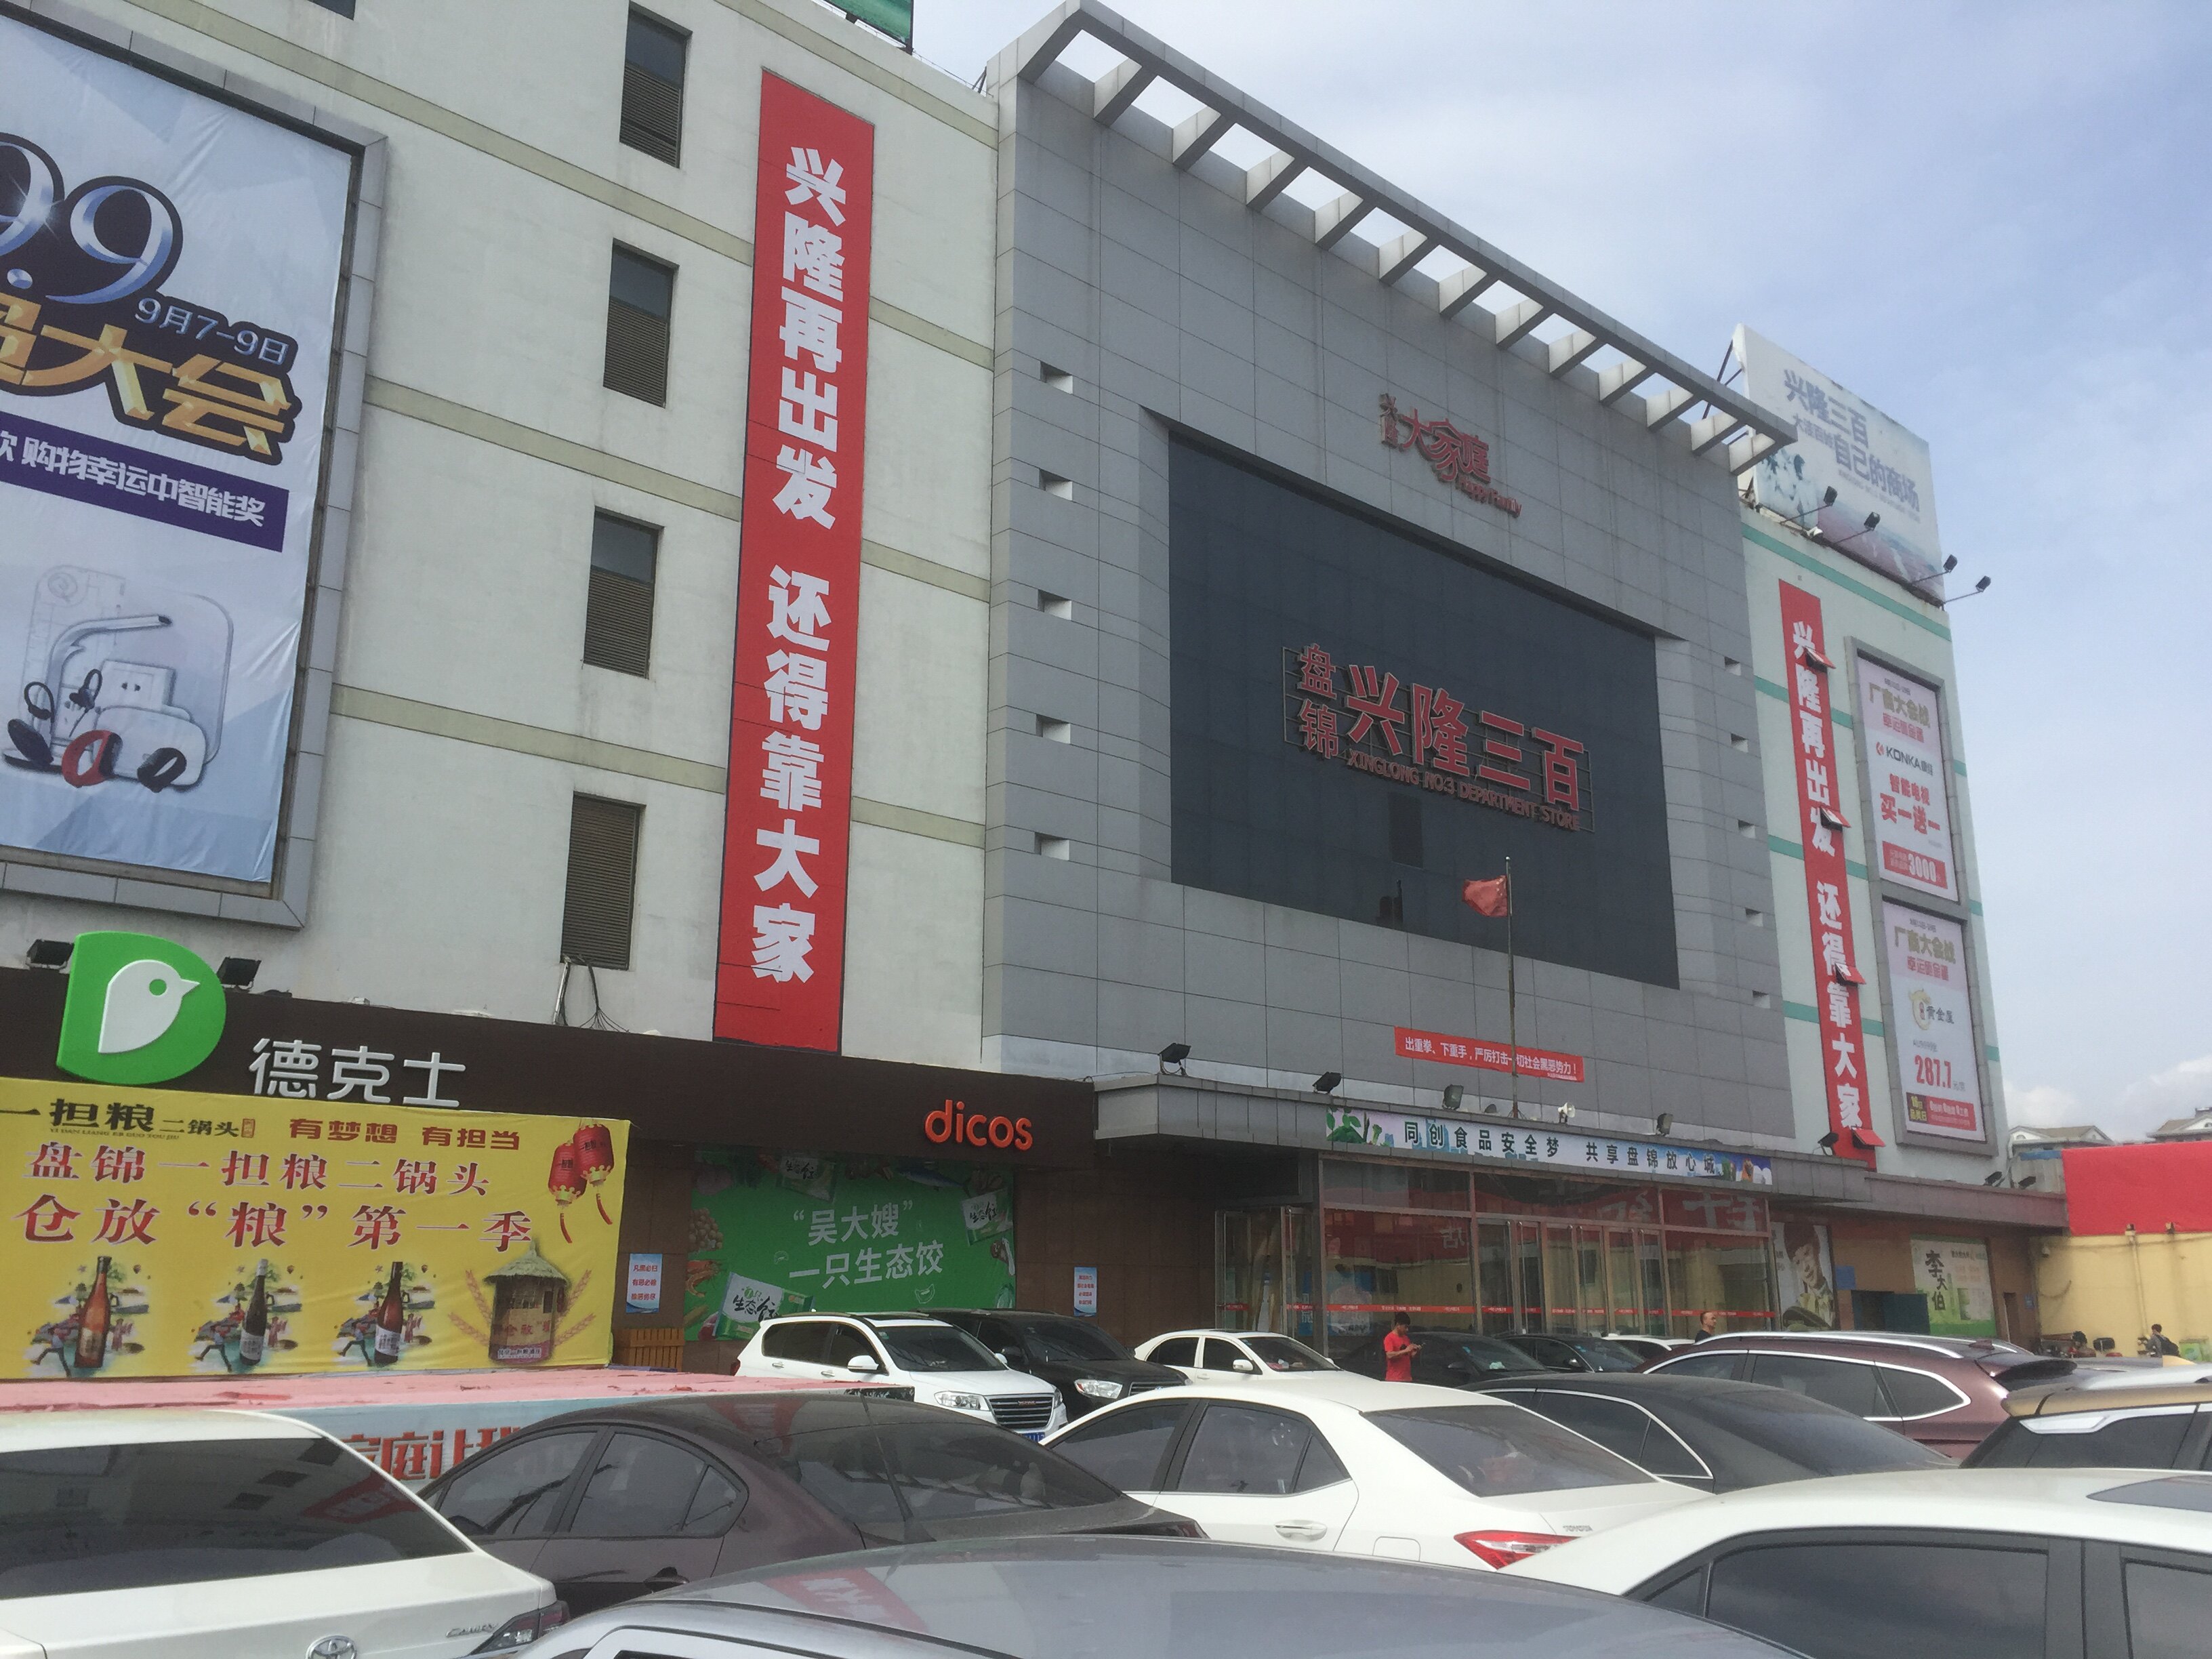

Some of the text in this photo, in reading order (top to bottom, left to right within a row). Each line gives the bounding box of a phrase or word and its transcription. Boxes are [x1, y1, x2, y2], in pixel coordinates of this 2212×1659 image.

[135, 297, 289, 366] 9月7-9日
[772, 146, 846, 530] 兴隆再出发
[1399, 407, 1492, 483] 大家庭
[22, 436, 266, 527] 购物幸运中智能奖
[1296, 643, 1339, 760] 盘锦
[1345, 663, 1584, 812] 兴隆三百
[1886, 746, 1921, 771] KONKA
[750, 565, 832, 983] 还得靠大家
[1347, 747, 1420, 785] XINGLONG
[1457, 781, 1538, 819] DEPARTMENT
[1539, 805, 1581, 832] STORE
[1880, 792, 1941, 835] 买一送一
[1908, 853, 1938, 882] 3000
[249, 1038, 467, 1108] 德克士
[159, 1118, 240, 1138] 二锅头
[288, 1118, 521, 1151] 有梦想 有担当
[924, 1099, 1033, 1151] dicos
[1405, 1121, 1559, 1158] 同创食品安全梦
[24, 1141, 491, 1197] 盘锦一担粮二锅头
[15, 1193, 533, 1252] 仓放“粮”第一季
[788, 1239, 945, 1290] 一只生态饺
[1925, 1249, 1948, 1311] 李大伯
